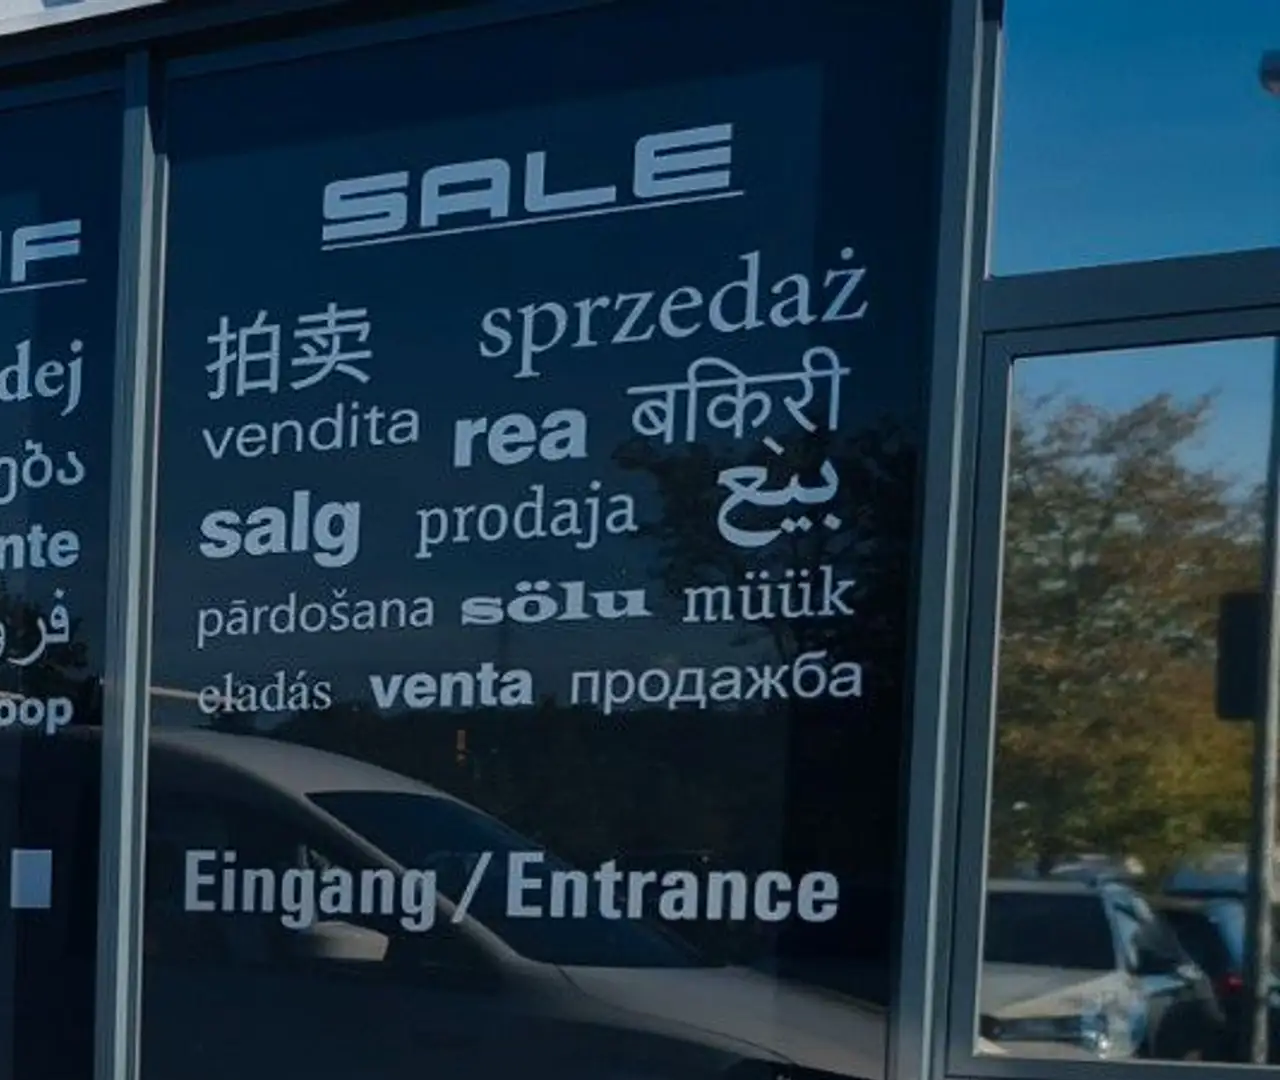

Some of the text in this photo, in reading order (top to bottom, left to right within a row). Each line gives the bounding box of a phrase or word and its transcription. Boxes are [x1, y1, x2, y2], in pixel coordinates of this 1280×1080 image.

[322, 123, 733, 241] SALE
[205, 303, 373, 400] 拍卖
[479, 246, 869, 378] sprzedaż
[202, 401, 588, 467] vendita rea
[199, 483, 639, 567] salg prodaja
[197, 566, 855, 648] pārdošana sölu müük
[197, 660, 533, 714] eladás venta
[569, 650, 863, 715] продажба
[183, 848, 438, 932] Eingang
[505, 852, 840, 923] Entrance
